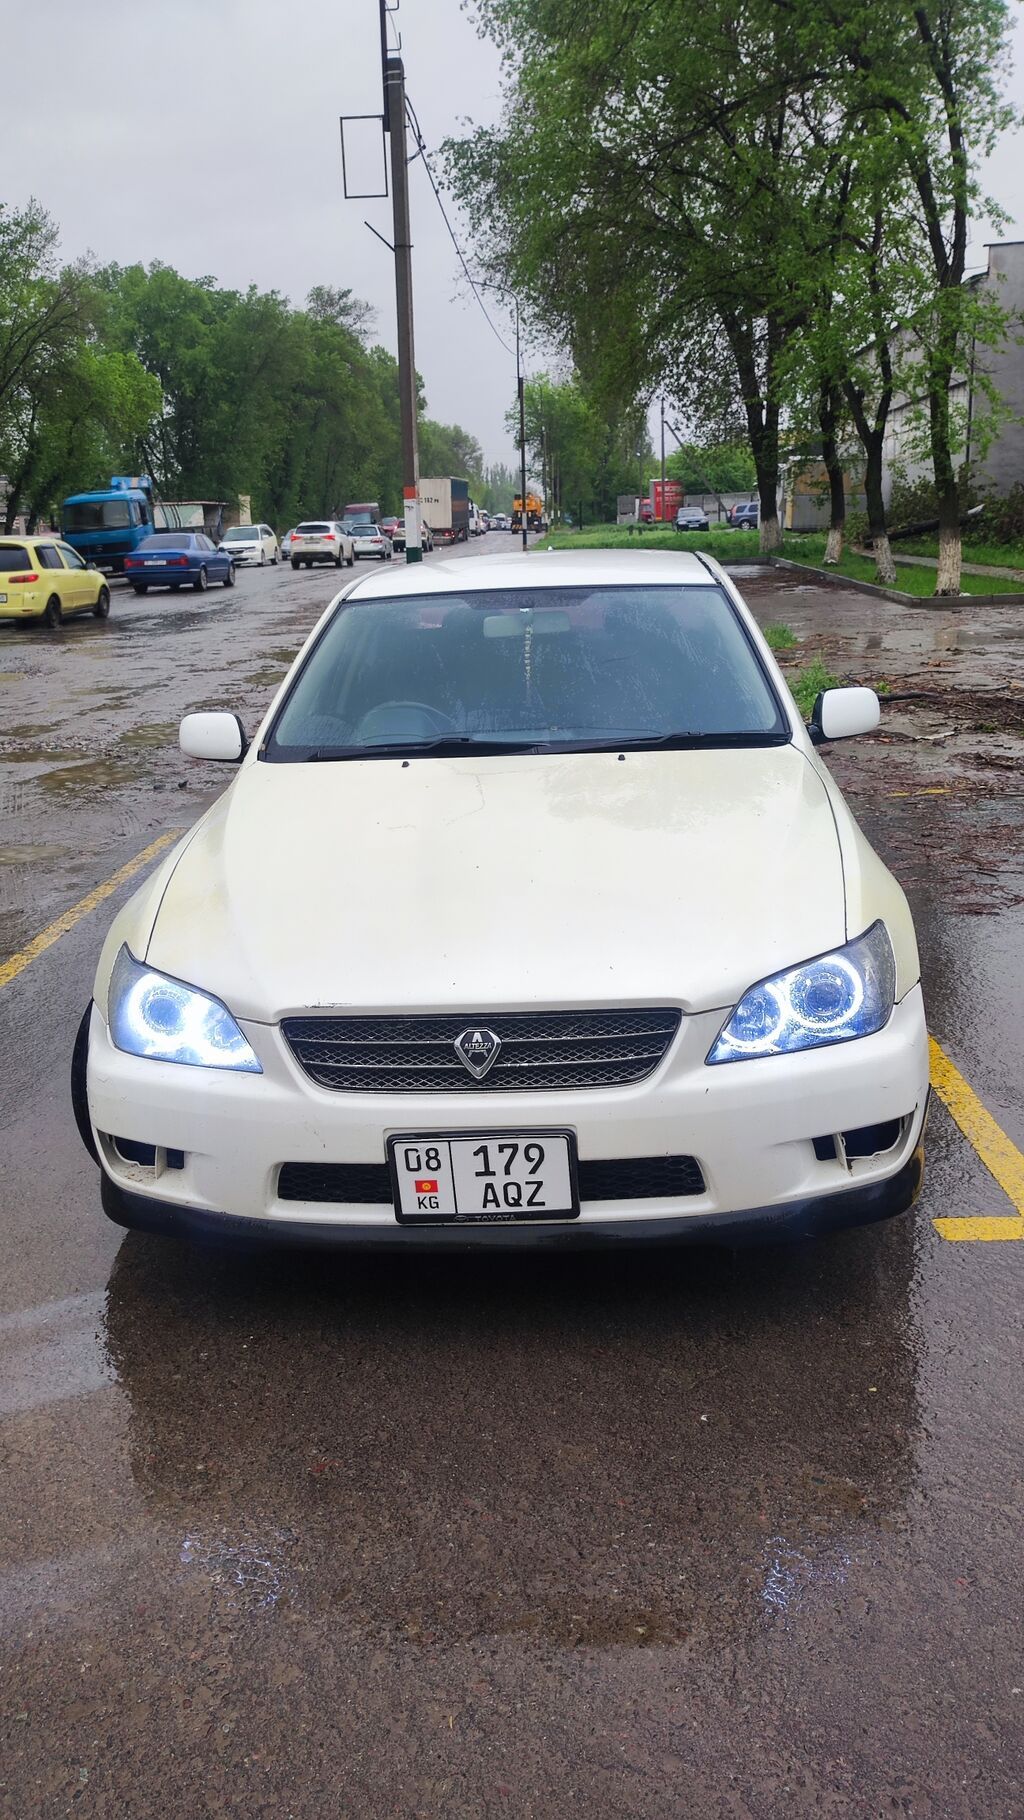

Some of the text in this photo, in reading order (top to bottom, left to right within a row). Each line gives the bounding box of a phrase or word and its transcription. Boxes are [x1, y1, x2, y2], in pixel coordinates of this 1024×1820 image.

[464, 1042, 492, 1050] ALTEZZA
[404, 1147, 442, 1172] 08
[473, 1143, 545, 1177] 179
[417, 1196, 439, 1210] KG
[482, 1180, 546, 1209] AQZ
[475, 1214, 516, 1223] TOYOTA
